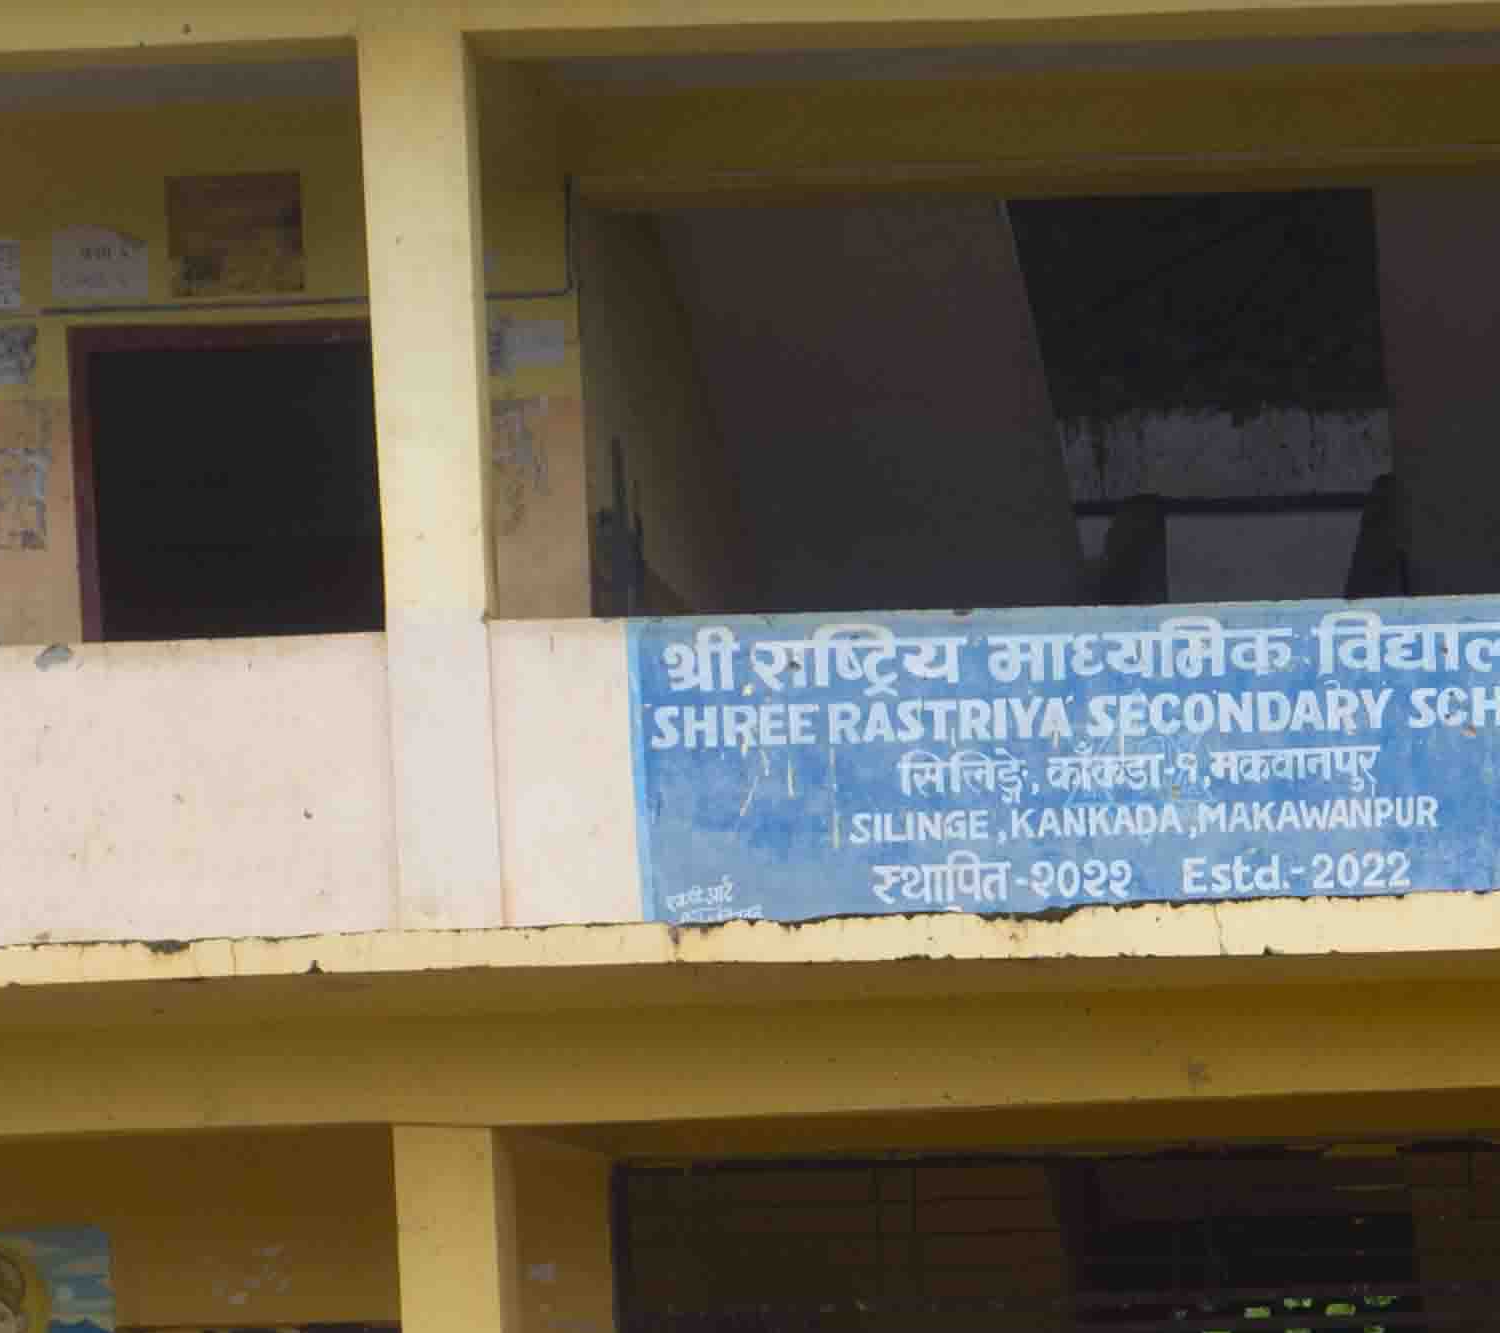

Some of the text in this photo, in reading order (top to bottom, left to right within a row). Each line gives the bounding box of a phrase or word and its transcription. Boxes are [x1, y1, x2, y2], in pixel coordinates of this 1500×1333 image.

[664, 625, 740, 692] श्री
[750, 623, 968, 697] राष्ट्रिय
[986, 616, 1293, 683] माध्यमिक
[651, 702, 818, 750] SHREE
[828, 697, 1071, 745] RASTRIYA
[1086, 688, 1393, 737] SECONDARY
[1199, 795, 1439, 834] MAKAWANPUR
